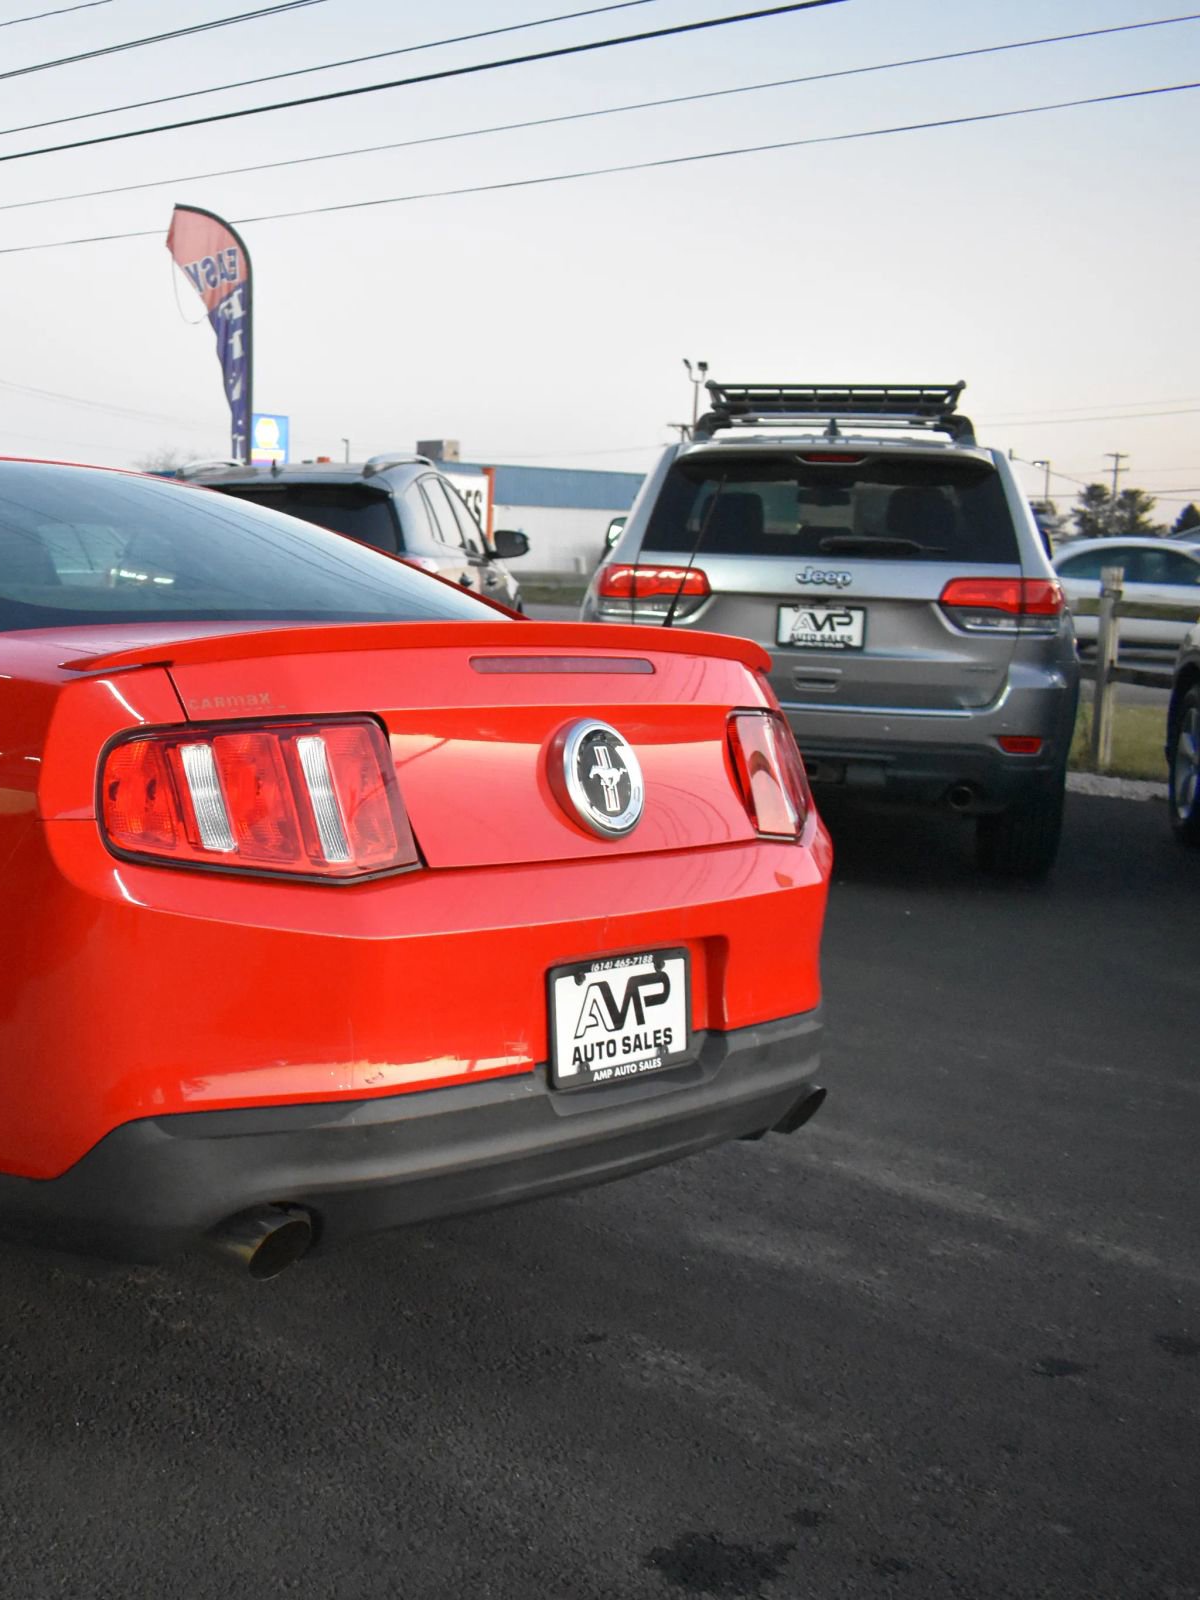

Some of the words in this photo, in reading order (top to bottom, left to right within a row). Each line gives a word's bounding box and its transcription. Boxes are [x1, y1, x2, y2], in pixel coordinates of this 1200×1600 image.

[795, 566, 853, 589] Jeep
[790, 633, 817, 642] AUTO
[820, 633, 853, 643] SALES
[591, 961, 613, 972] (614)
[572, 1038, 617, 1066] AUTO
[622, 1027, 673, 1055] SALES
[593, 1072, 613, 1082] AMP
[614, 1064, 638, 1077] AUTO
[639, 1058, 662, 1071] SALES
